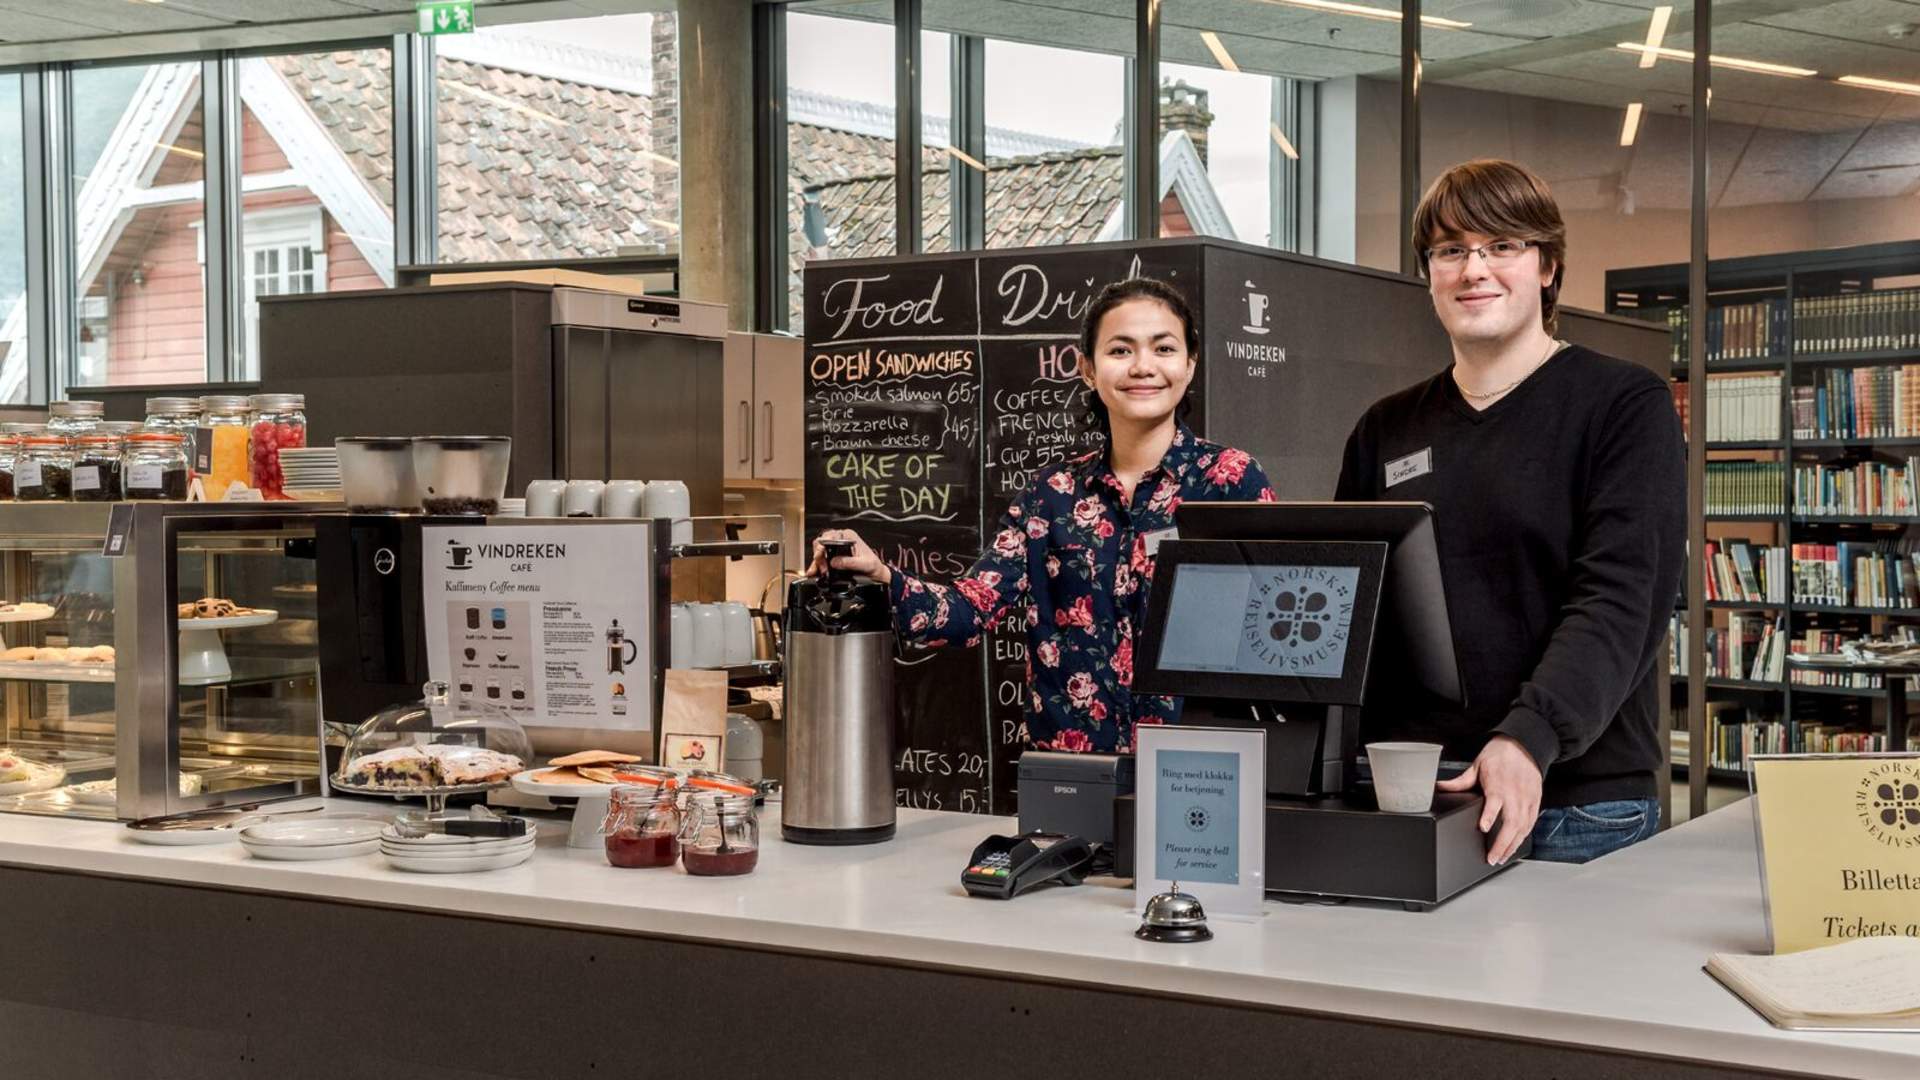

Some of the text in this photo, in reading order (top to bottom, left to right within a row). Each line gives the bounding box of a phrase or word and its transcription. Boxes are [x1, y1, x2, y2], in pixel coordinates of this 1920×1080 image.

[823, 273, 945, 339] Food
[1039, 345, 1080, 378] HO
[1226, 341, 1286, 362] VINDREKEN
[810, 349, 975, 381] OPEN SANDWICHES
[815, 386, 882, 407] Smoked
[887, 385, 942, 403] salmon
[822, 407, 855, 422] Brie
[822, 417, 909, 433] Mozzarella
[997, 412, 1076, 437] FRENCH
[880, 434, 931, 448] cheese
[1027, 430, 1076, 446] freshly
[826, 452, 945, 480] CAKE OF
[838, 483, 951, 515] THE DAY
[477, 543, 567, 559] VINDREKEN
[489, 580, 517, 595] Coffee
[1273, 567, 1341, 589] NORSK
[1244, 598, 1353, 671] REISELIVSMUSEUM
[896, 746, 953, 776] ATES
[896, 787, 943, 811] ELLYS
[1054, 785, 1078, 795] EPSON
[1841, 868, 1920, 892] Billetta
[1823, 916, 1898, 938] Tickets
